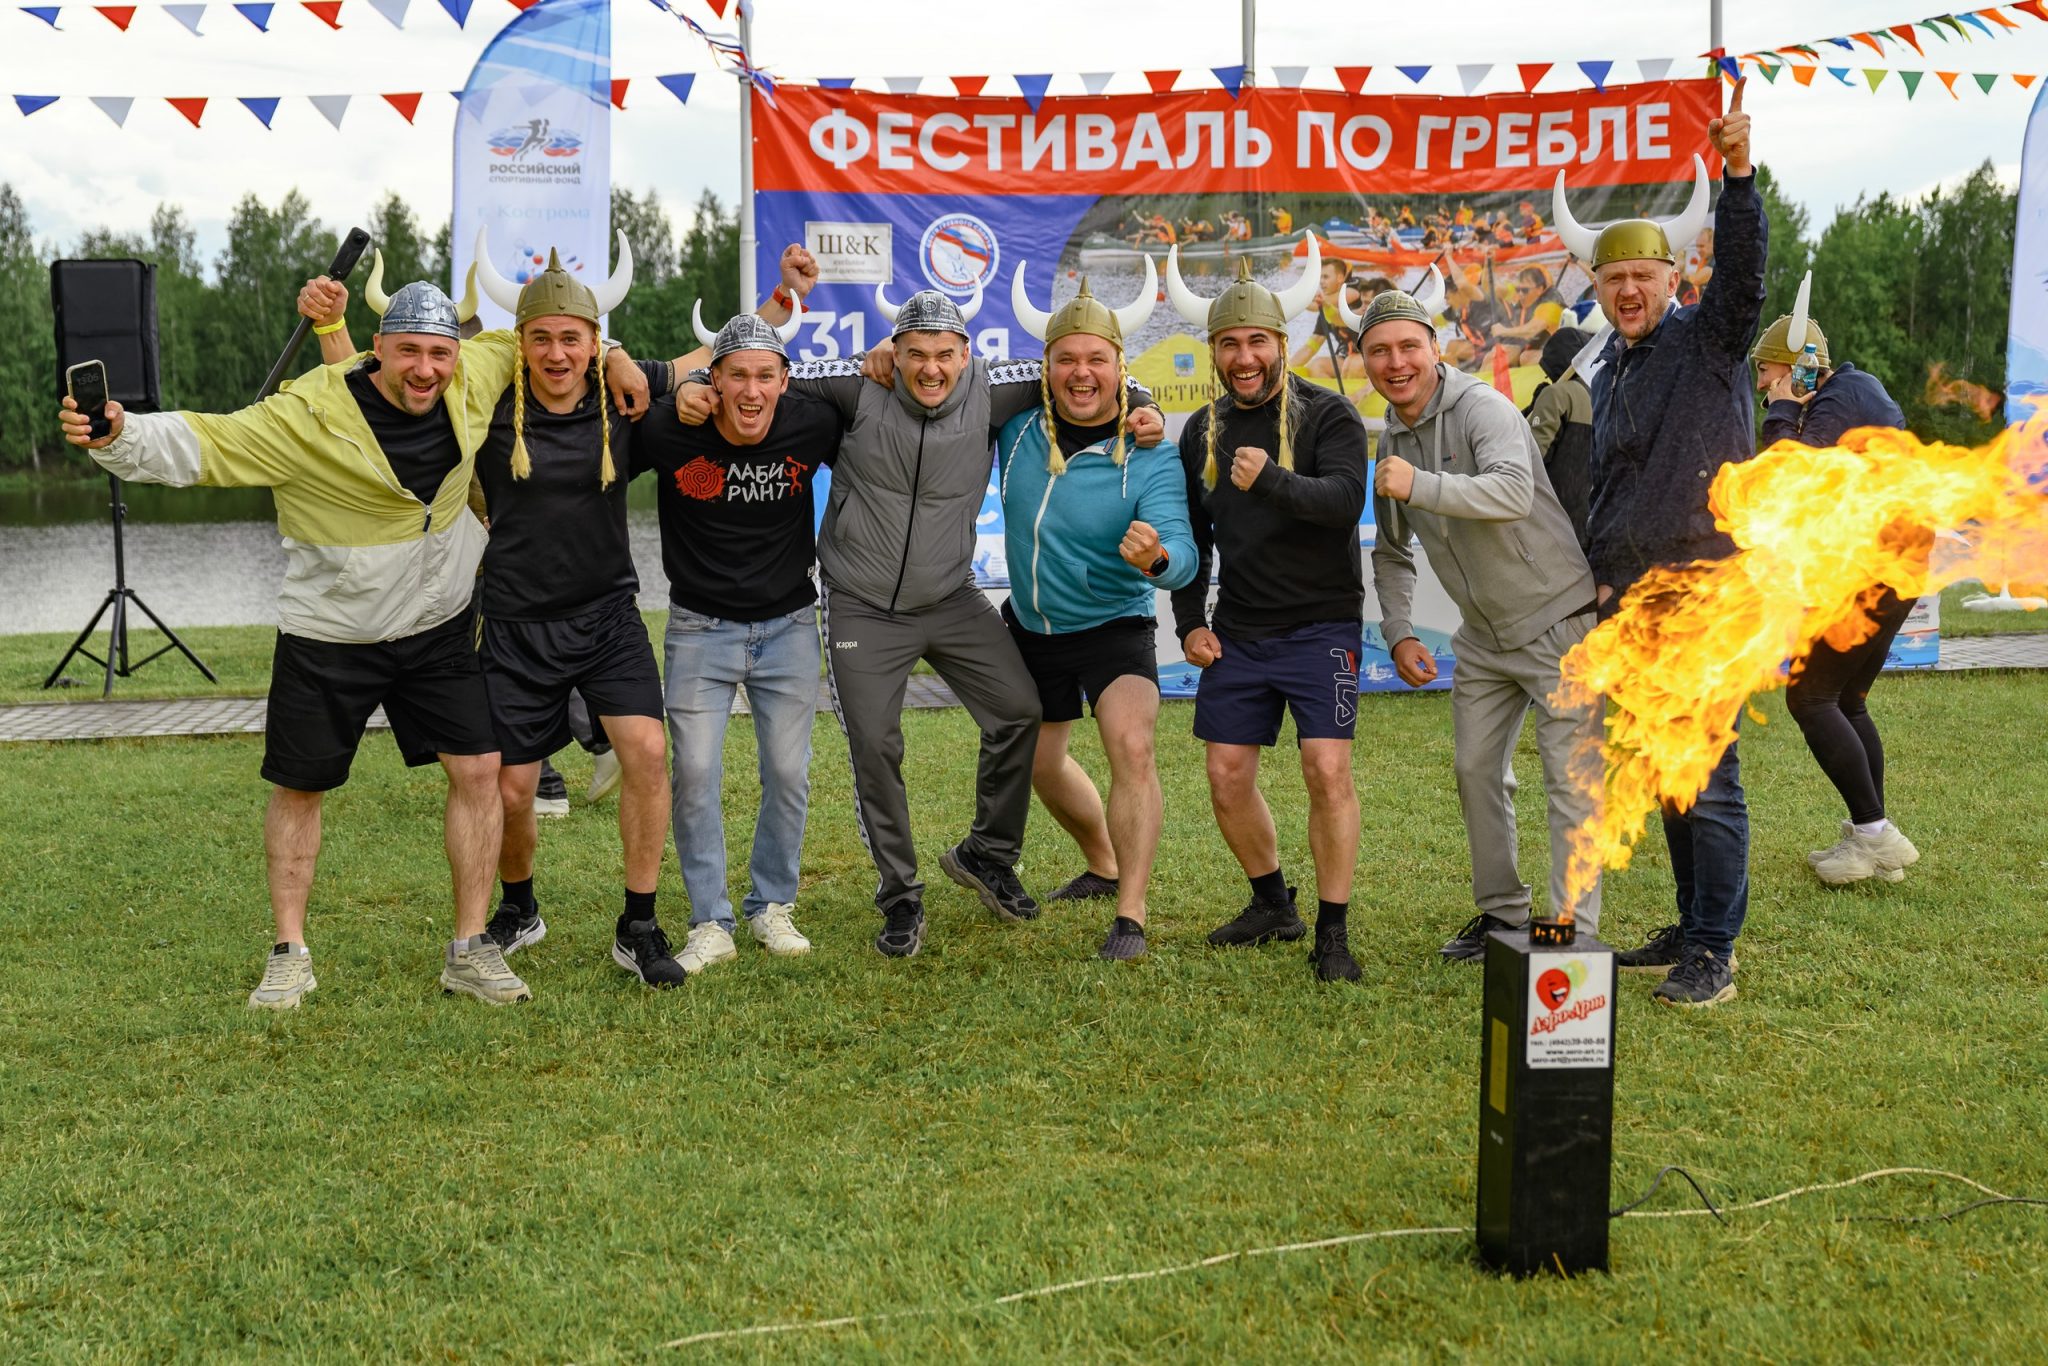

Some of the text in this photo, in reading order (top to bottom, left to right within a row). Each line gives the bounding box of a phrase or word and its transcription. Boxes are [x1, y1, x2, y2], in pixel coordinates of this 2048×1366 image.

[808, 102, 1671, 171] ФЕСТИВАЛЬ ПО ГРЕБЛЕ
[489, 163, 581, 175] РОССИЙСКИЙ
[489, 176, 581, 185] СПОРТИВНЫЙ ФОНД
[497, 204, 591, 222] Кострома
[799, 312, 865, 361] 31
[727, 462, 785, 484] ЛАБИ
[727, 482, 790, 503] РИНТ
[1330, 648, 1357, 726] FILA
